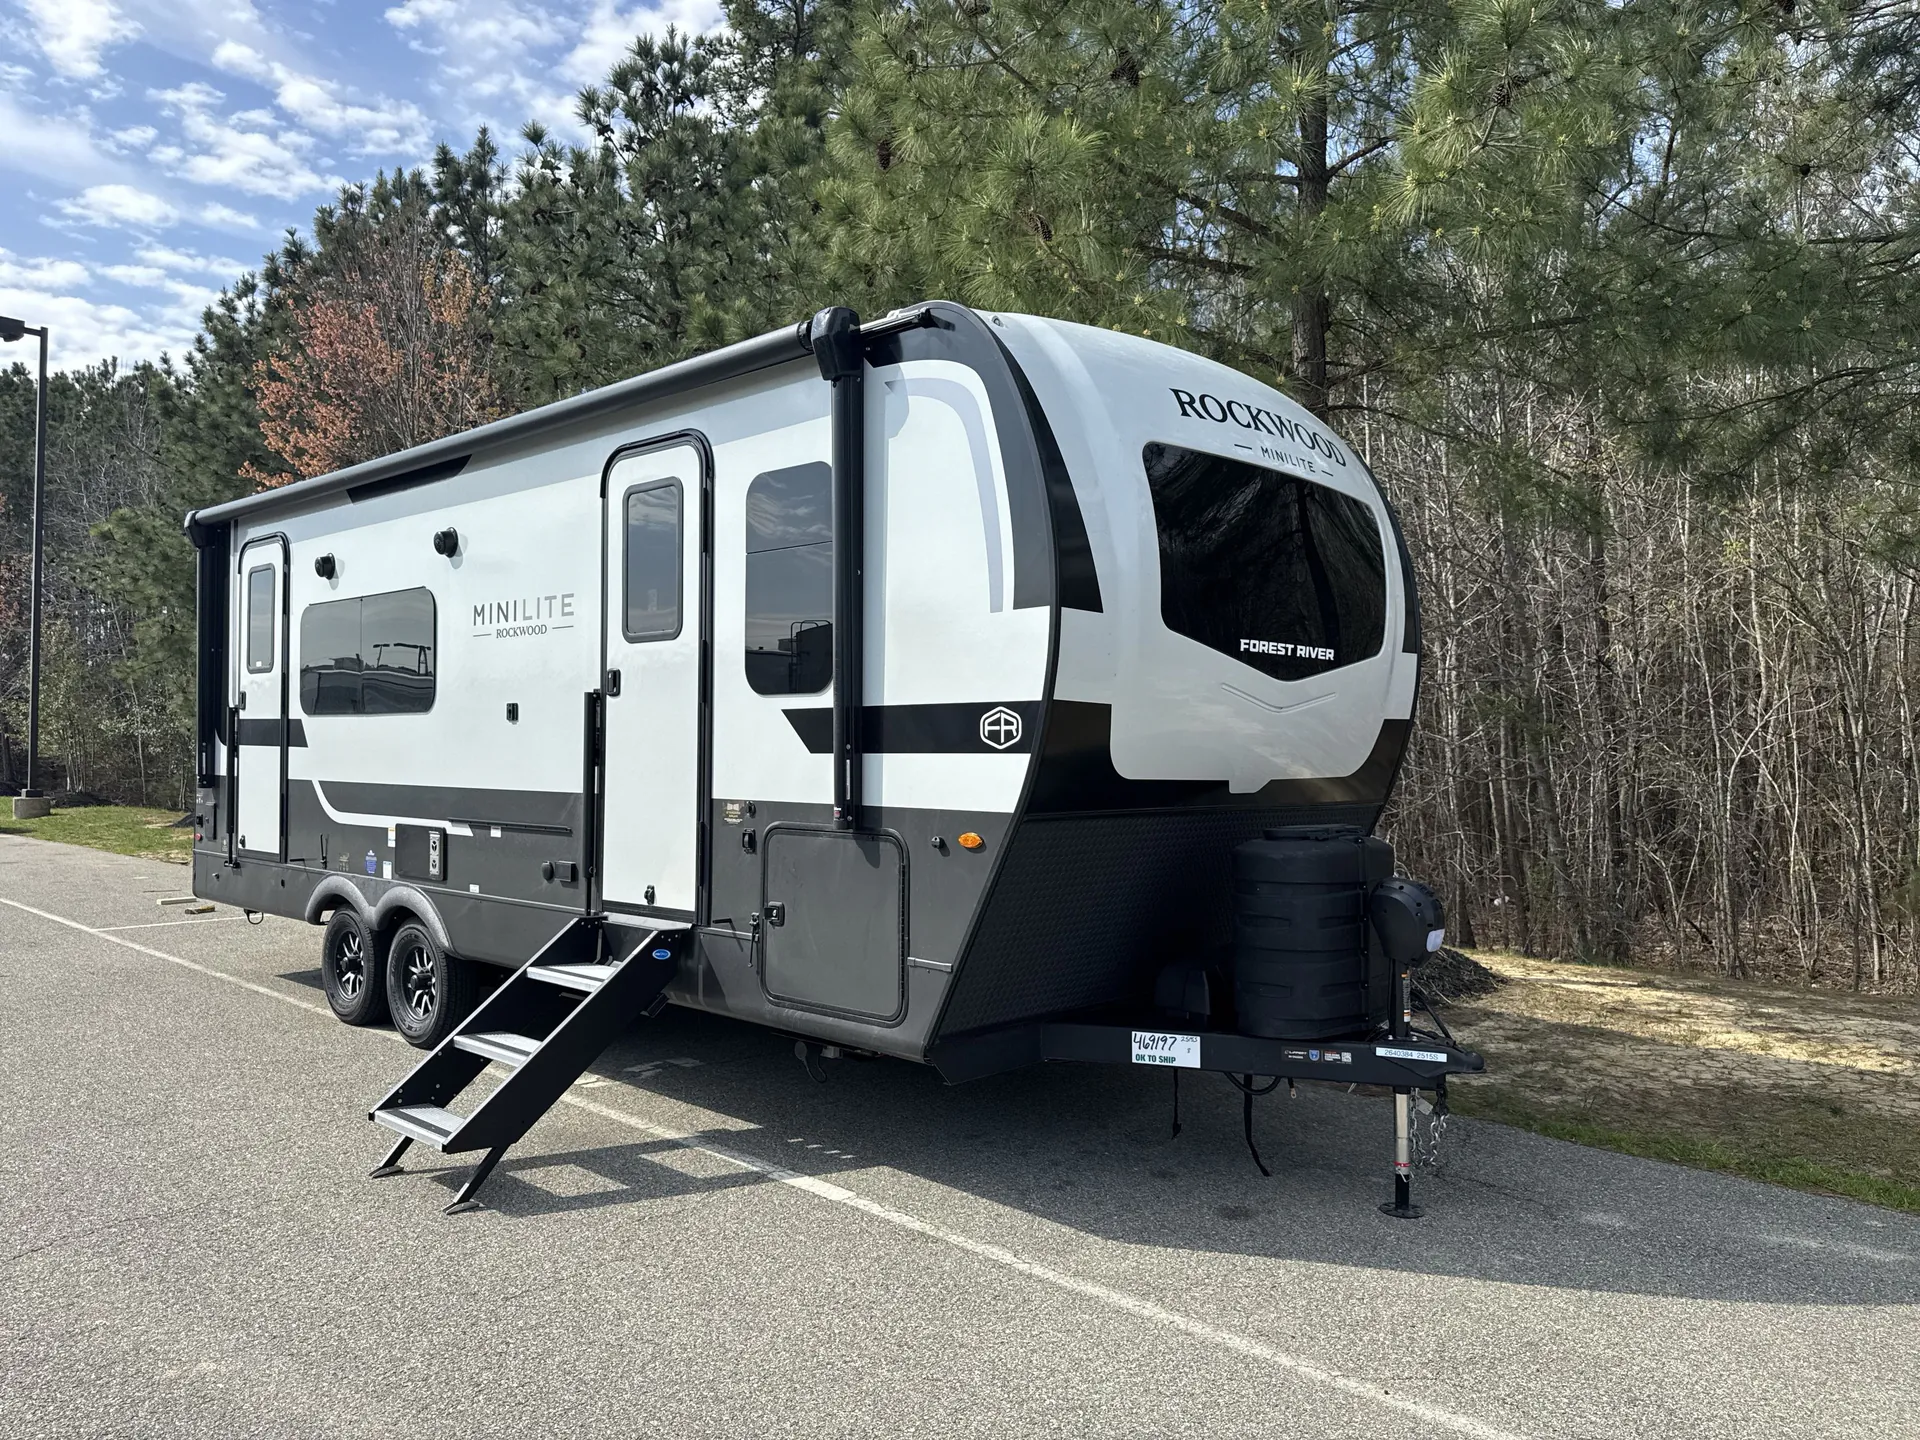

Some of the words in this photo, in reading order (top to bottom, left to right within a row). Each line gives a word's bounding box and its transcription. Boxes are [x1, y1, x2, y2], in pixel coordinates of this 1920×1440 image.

[1169, 388, 1347, 467] ROCKWOOD
[1260, 446, 1316, 473] MINILITE
[473, 593, 575, 627] MINILITE
[496, 624, 548, 639] ROCKWOOD
[1240, 639, 1295, 656] FOREST
[1296, 645, 1335, 661] RIVER
[1133, 1033, 1178, 1051] 469197
[1135, 1053, 1146, 1062] OK
[1147, 1054, 1157, 1063] TO
[1158, 1055, 1177, 1064] SHIP
